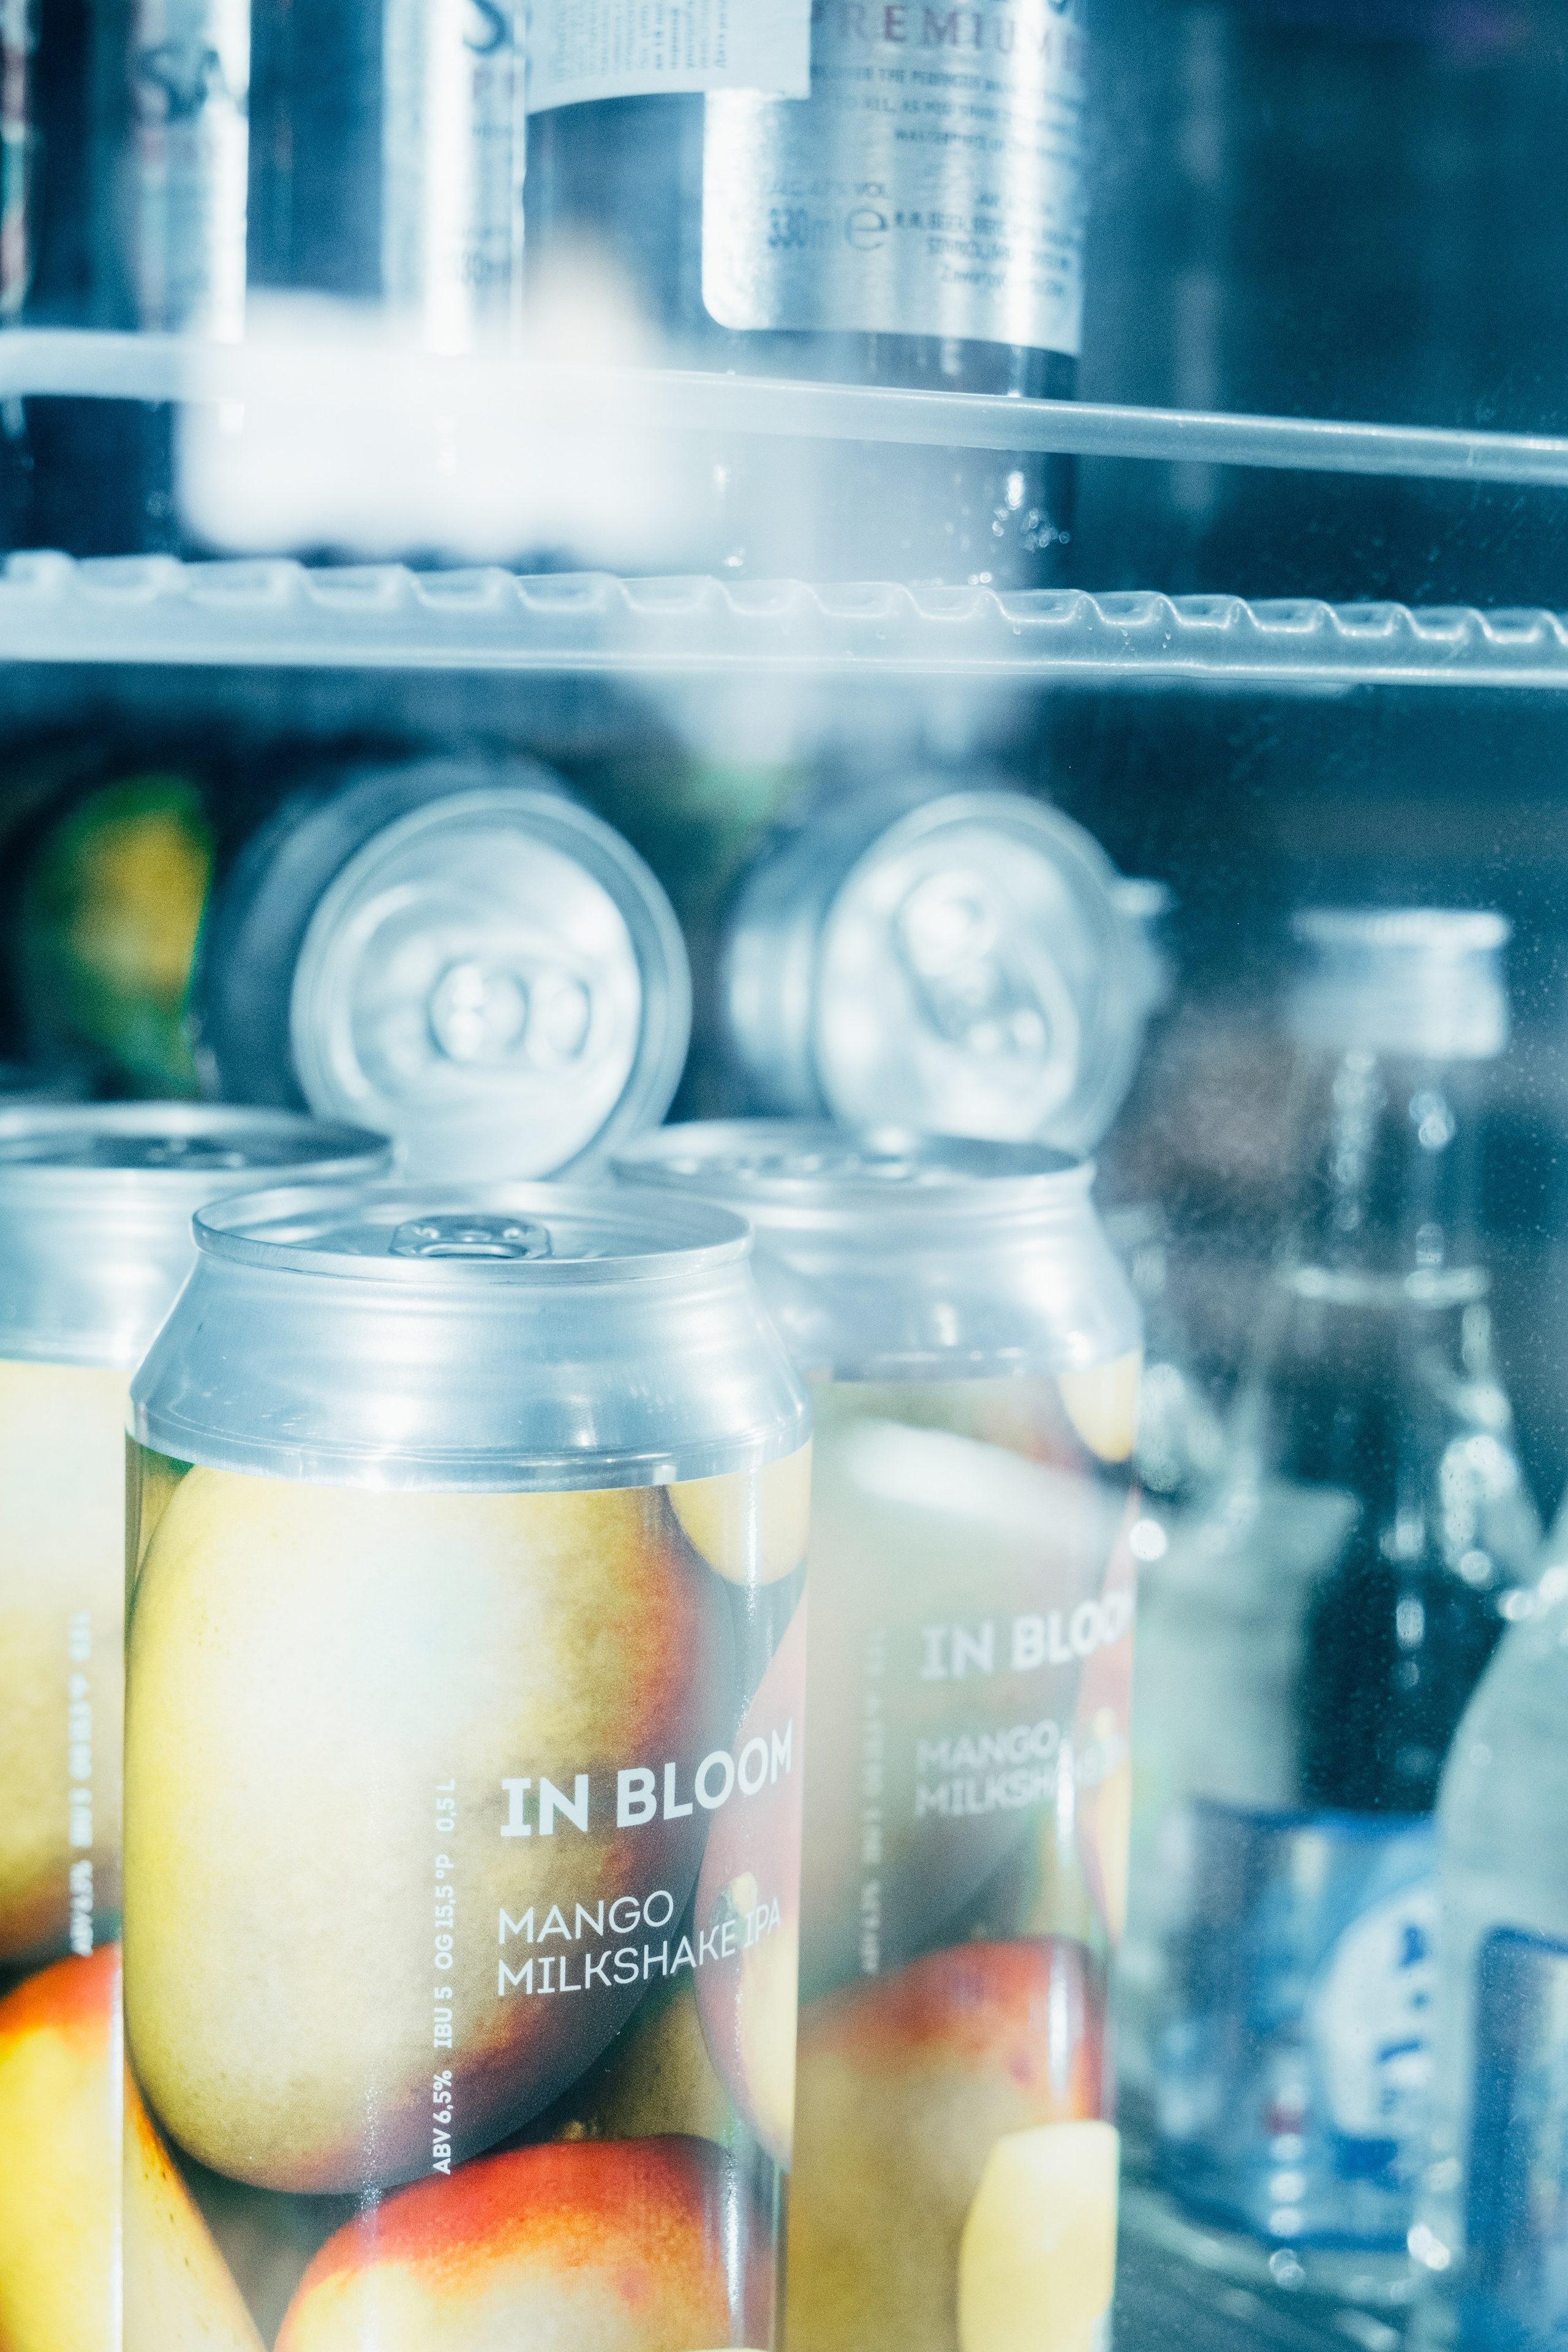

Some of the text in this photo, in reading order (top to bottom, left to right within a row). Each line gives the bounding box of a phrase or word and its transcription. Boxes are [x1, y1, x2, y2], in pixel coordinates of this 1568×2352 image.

[919, 1589, 1134, 1682] IN BLOO
[916, 1719, 1060, 1773] MANGO
[436, 1778, 456, 1792] L
[500, 1717, 793, 1838] IN BLOOM
[435, 1796, 458, 1832] 0,5
[434, 1884, 457, 1929] 15,5
[497, 1890, 674, 1945] MANGO
[434, 1933, 454, 1970] OG
[497, 1896, 782, 1996] MILKSHAKE IPA
[434, 1986, 453, 1999] 5
[433, 2007, 453, 2049] IBU
[432, 2070, 454, 2124] 6,5%
[432, 2127, 451, 2175] ABV
